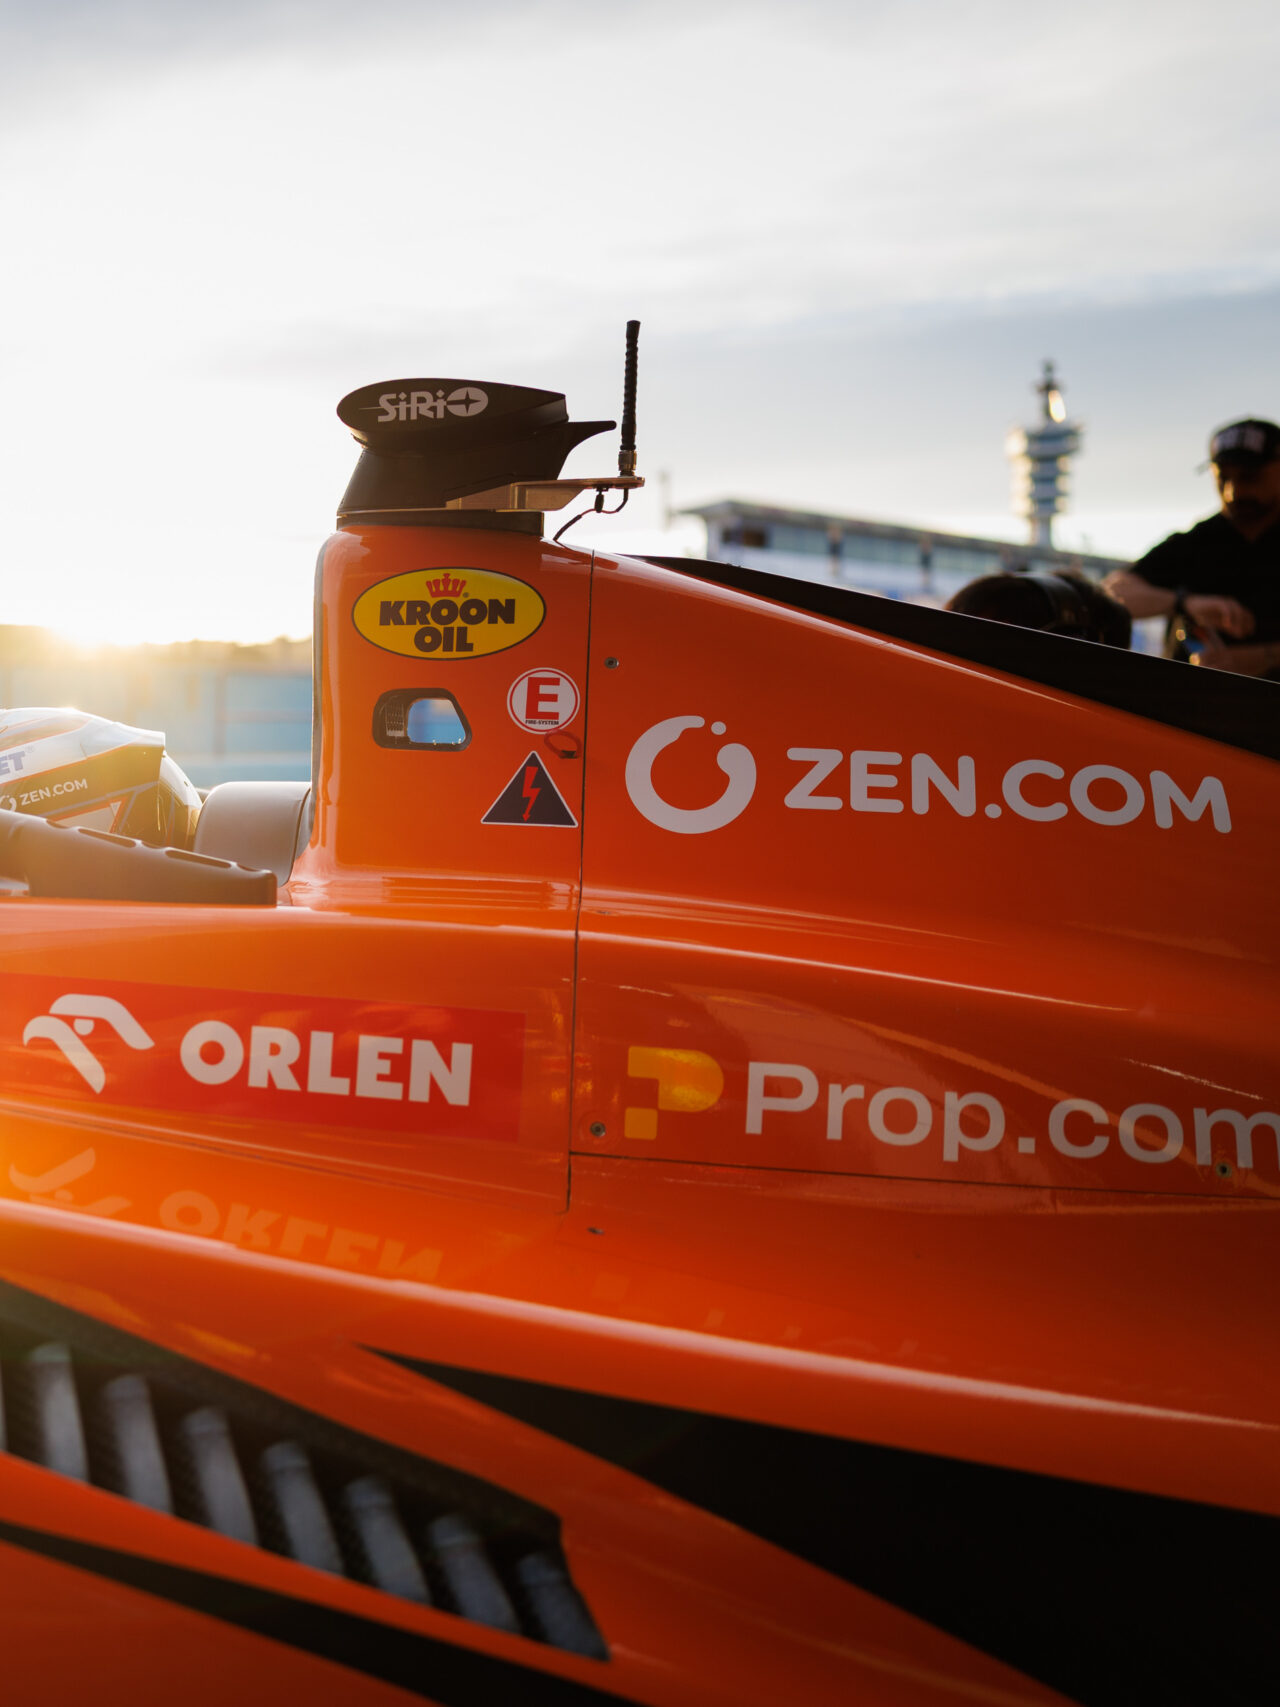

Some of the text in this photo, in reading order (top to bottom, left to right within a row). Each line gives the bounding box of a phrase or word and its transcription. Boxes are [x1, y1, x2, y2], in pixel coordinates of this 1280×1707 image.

[379, 599, 516, 626] KROON
[414, 626, 474, 653] OIL
[525, 677, 561, 720] E
[20, 777, 88, 807] ZEN.COM
[784, 746, 1232, 835] ZEN.COM
[180, 1020, 473, 1107] ORLEN
[745, 1061, 1280, 1169] Prop.com
